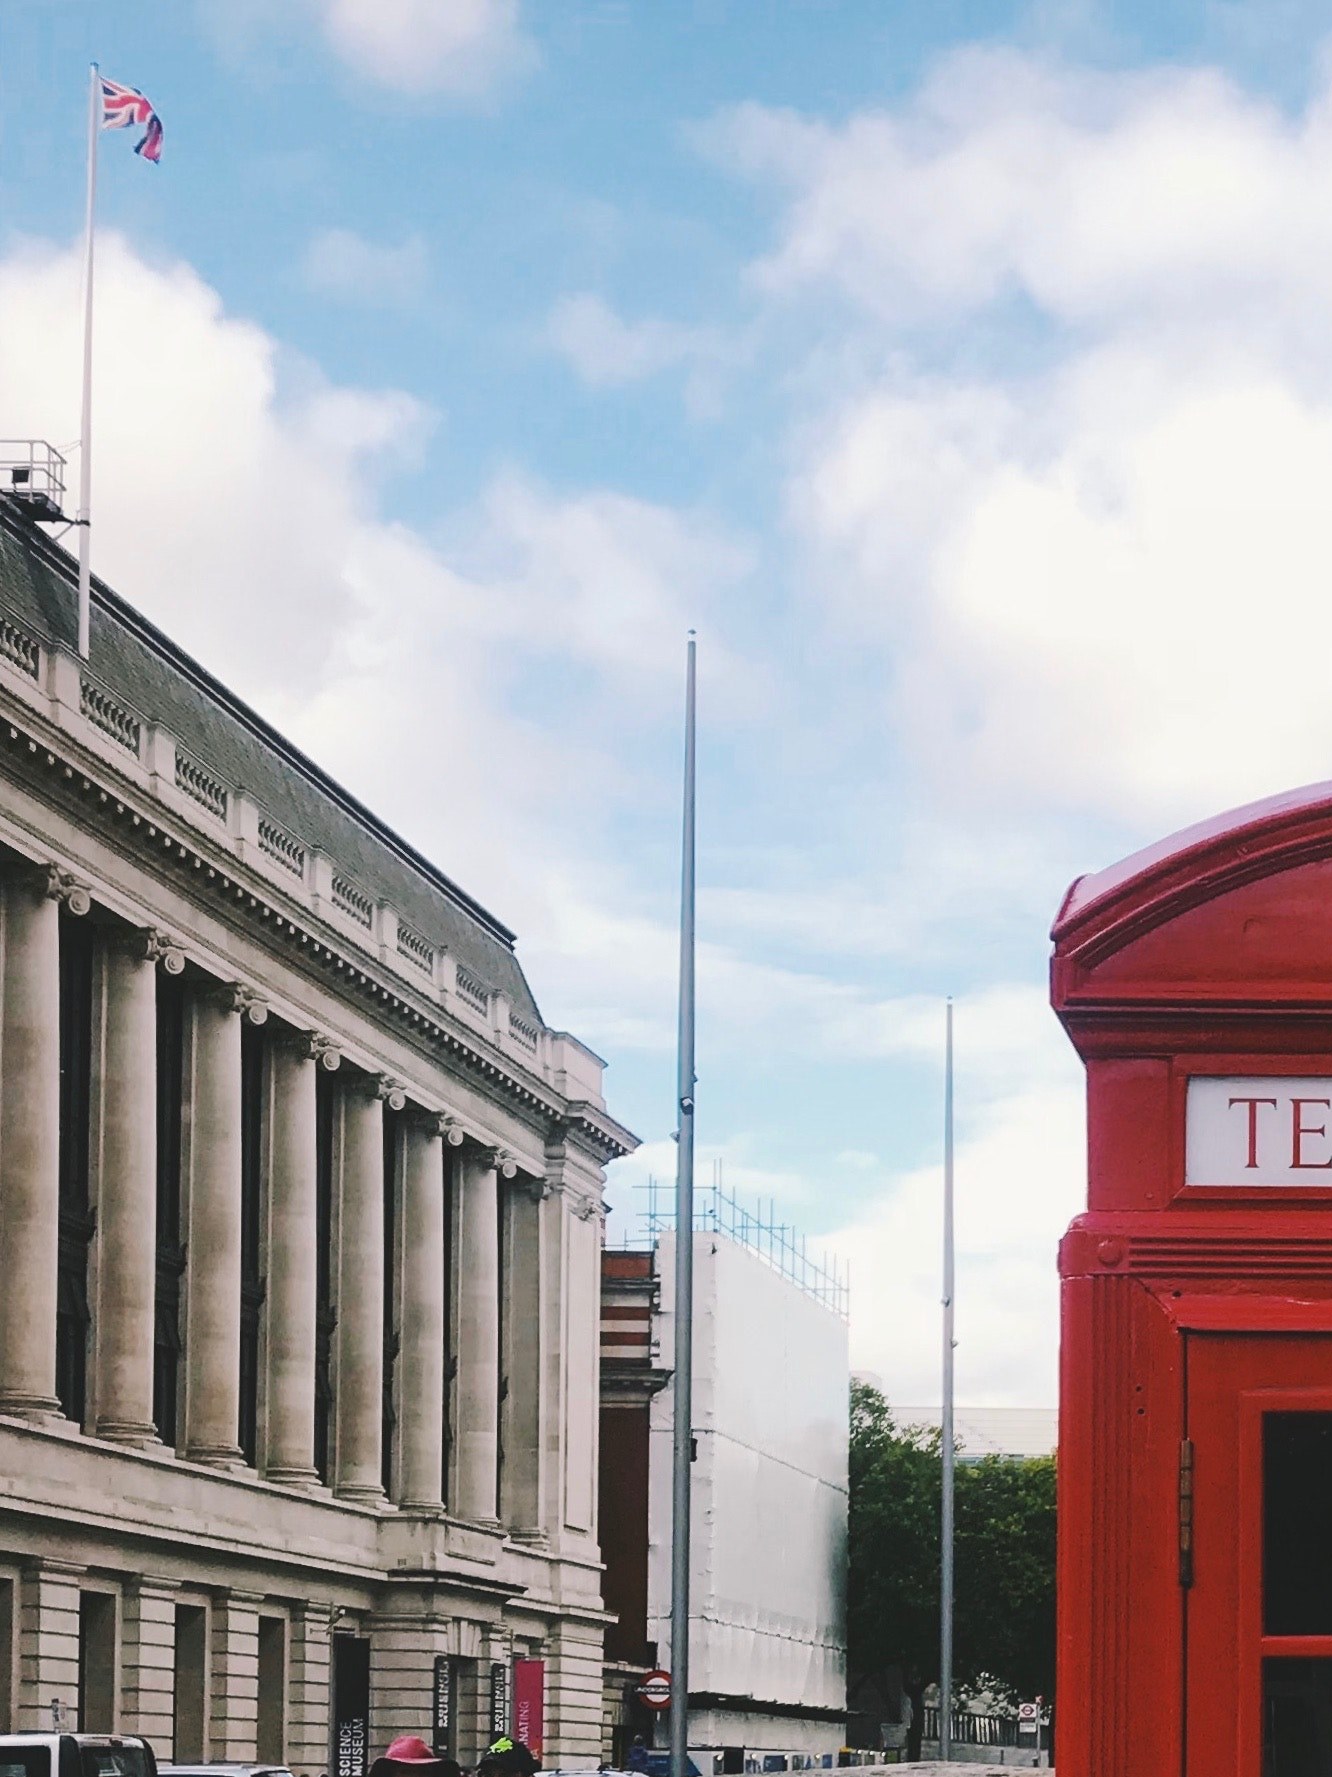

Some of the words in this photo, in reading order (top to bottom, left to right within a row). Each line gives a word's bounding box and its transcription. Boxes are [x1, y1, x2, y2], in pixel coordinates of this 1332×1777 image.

[339, 1722, 352, 1777] SCIENCE
[352, 1718, 364, 1777] MUSEUM
[519, 1701, 529, 1745] NATING
